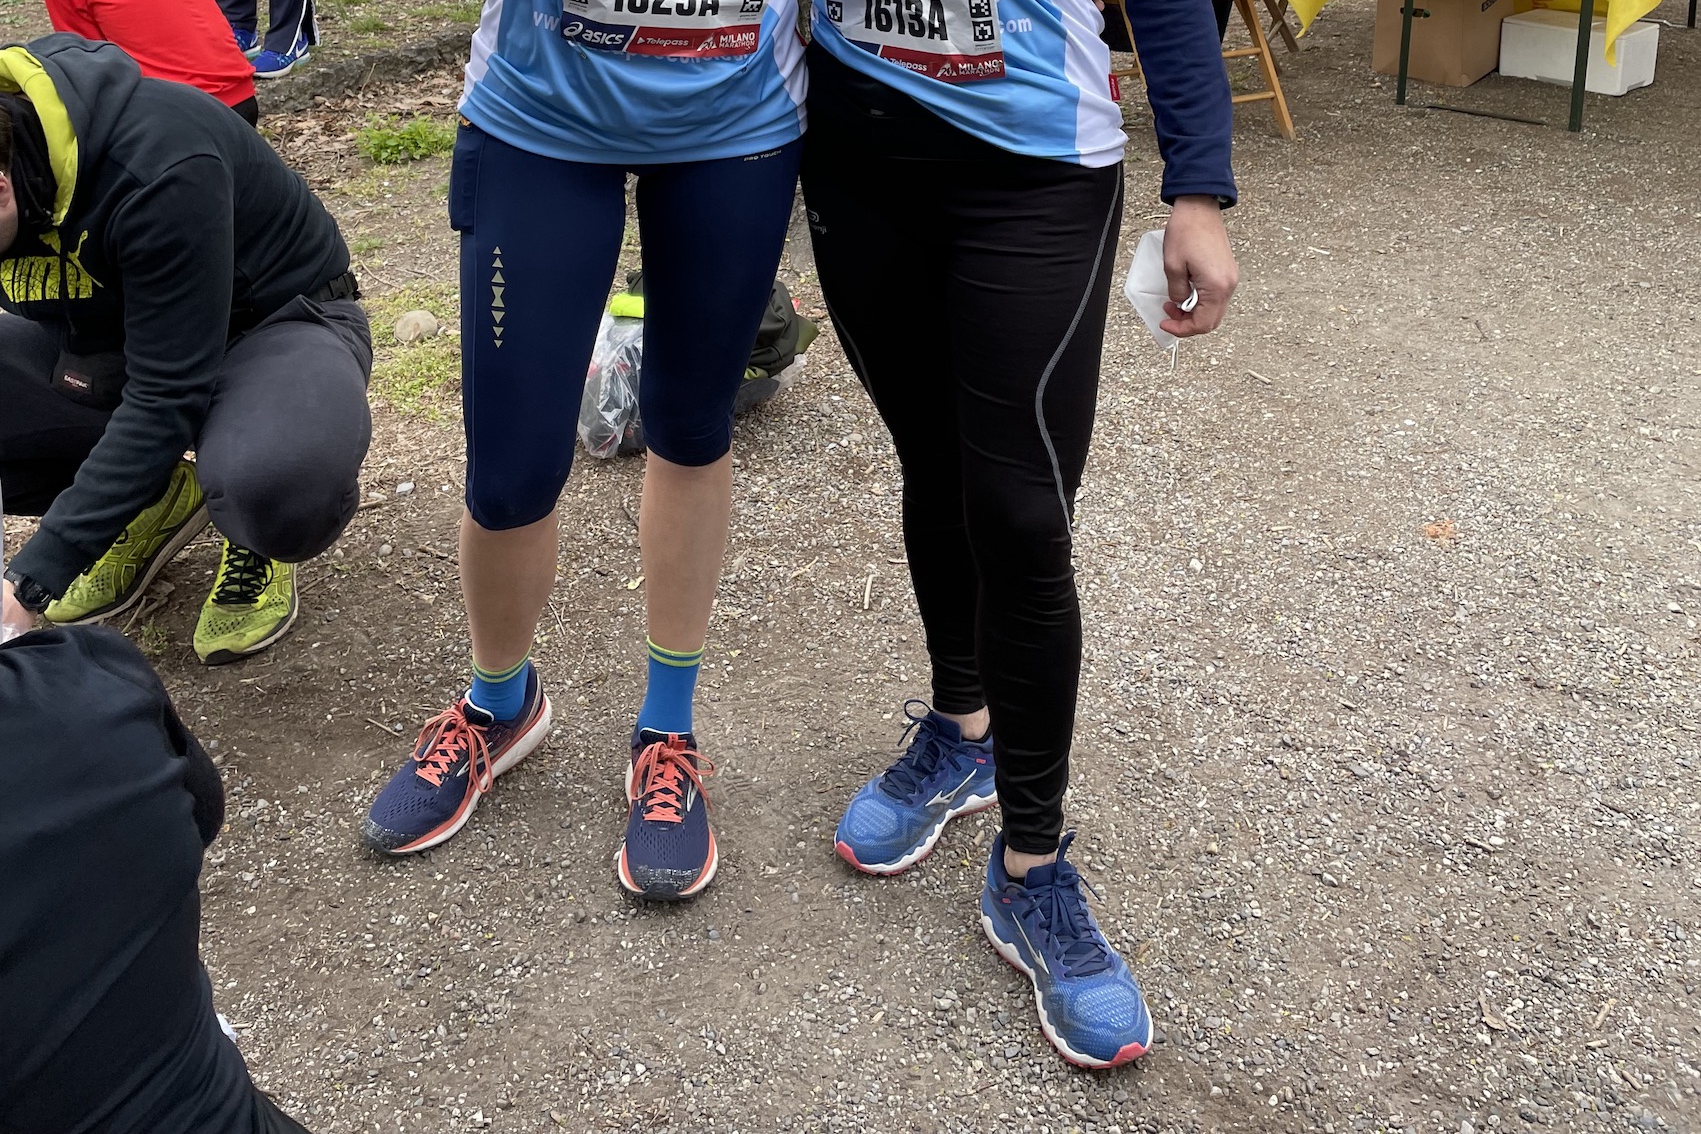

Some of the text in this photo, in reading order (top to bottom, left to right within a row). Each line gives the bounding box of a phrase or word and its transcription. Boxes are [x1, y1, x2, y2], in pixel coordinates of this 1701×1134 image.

[645, 37, 689, 47] Telepass
[719, 32, 755, 43] MILANO
[719, 39, 755, 48] MARATHON
[890, 57, 928, 72] Telepass
[958, 59, 1002, 70] MILANO
